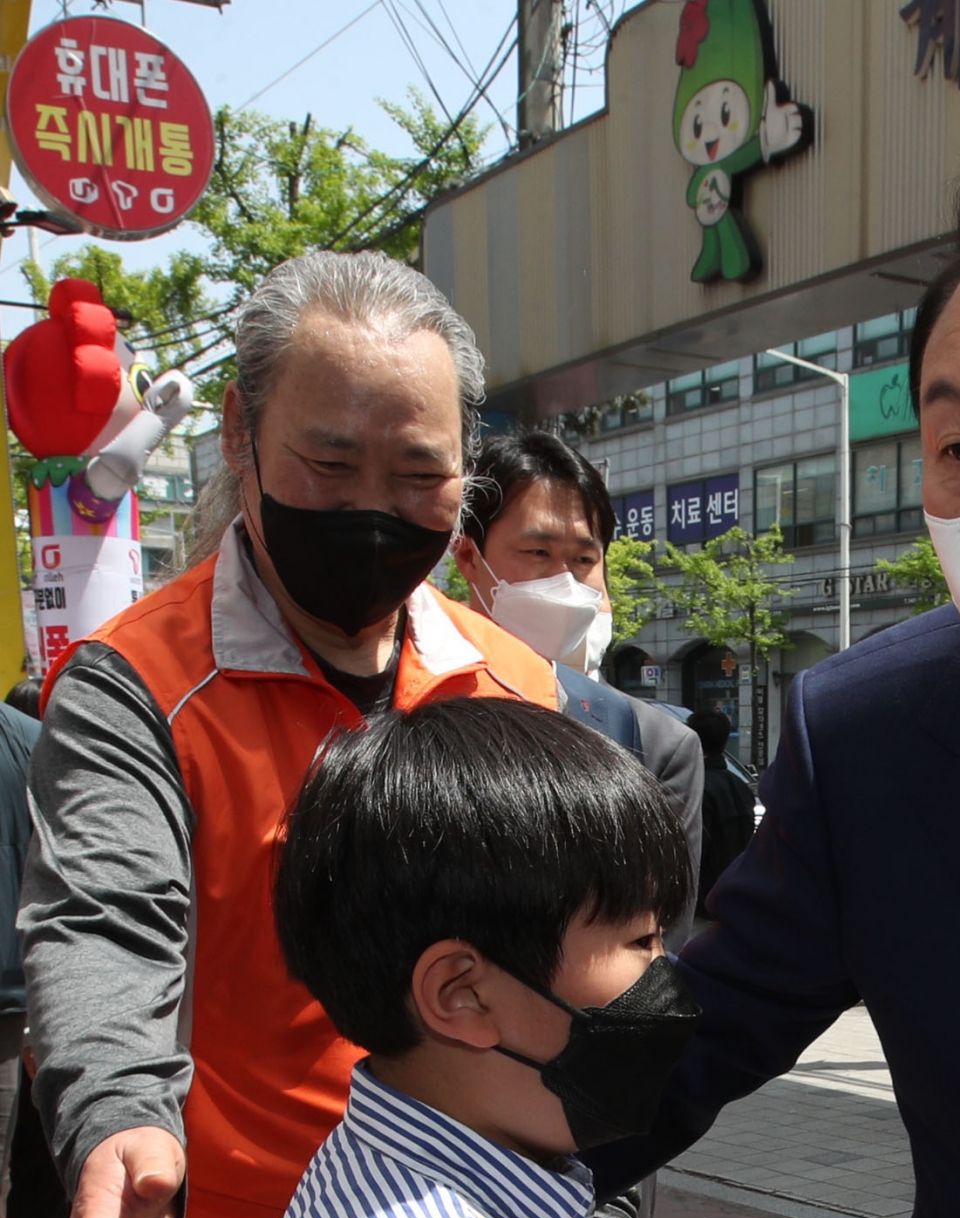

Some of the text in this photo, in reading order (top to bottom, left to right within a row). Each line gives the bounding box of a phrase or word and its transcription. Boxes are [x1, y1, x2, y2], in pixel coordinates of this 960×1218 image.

[54, 38, 169, 109] 휴대폰
[35, 103, 194, 176] 즉시개통
[626, 506, 653, 537] 운동
[671, 497, 702, 529] 치료
[706, 488, 738, 524] 센터
